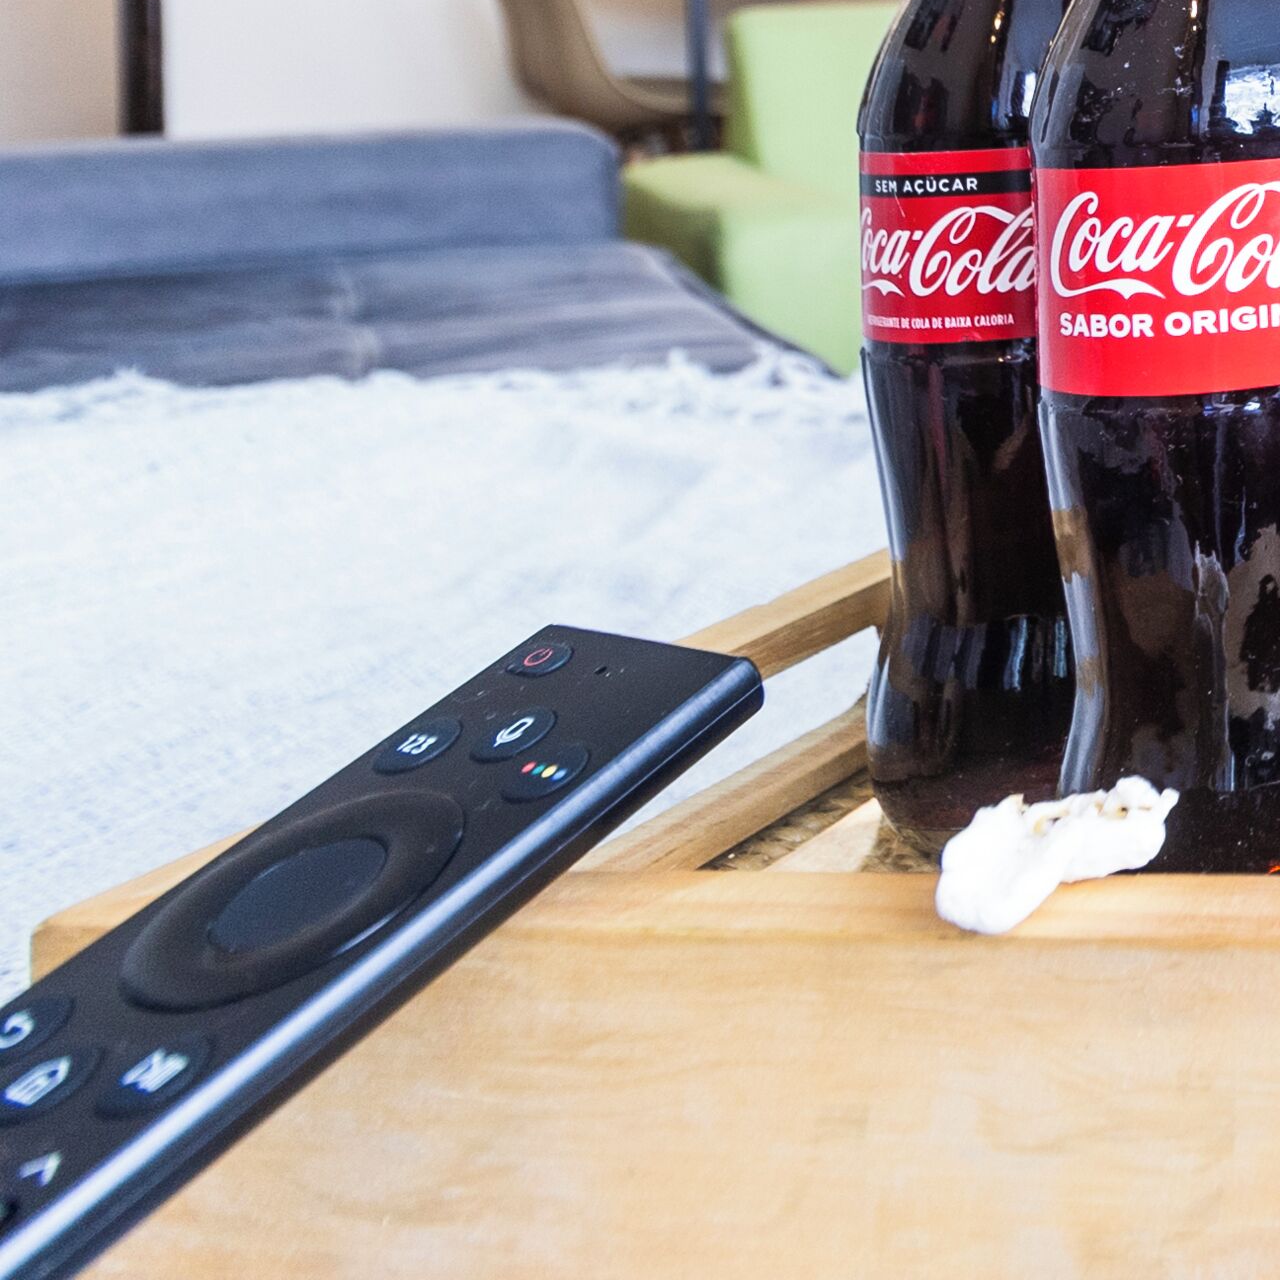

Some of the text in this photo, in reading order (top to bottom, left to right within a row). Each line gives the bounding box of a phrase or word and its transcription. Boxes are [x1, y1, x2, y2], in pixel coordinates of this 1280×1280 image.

[875, 179, 897, 193] SEM
[911, 317, 930, 329] COLA
[932, 316, 943, 329] DE
[944, 315, 972, 329] BAIXA
[974, 313, 1015, 327] CALORIA
[1060, 312, 1154, 338] SABOR
[396, 733, 438, 755] 123
